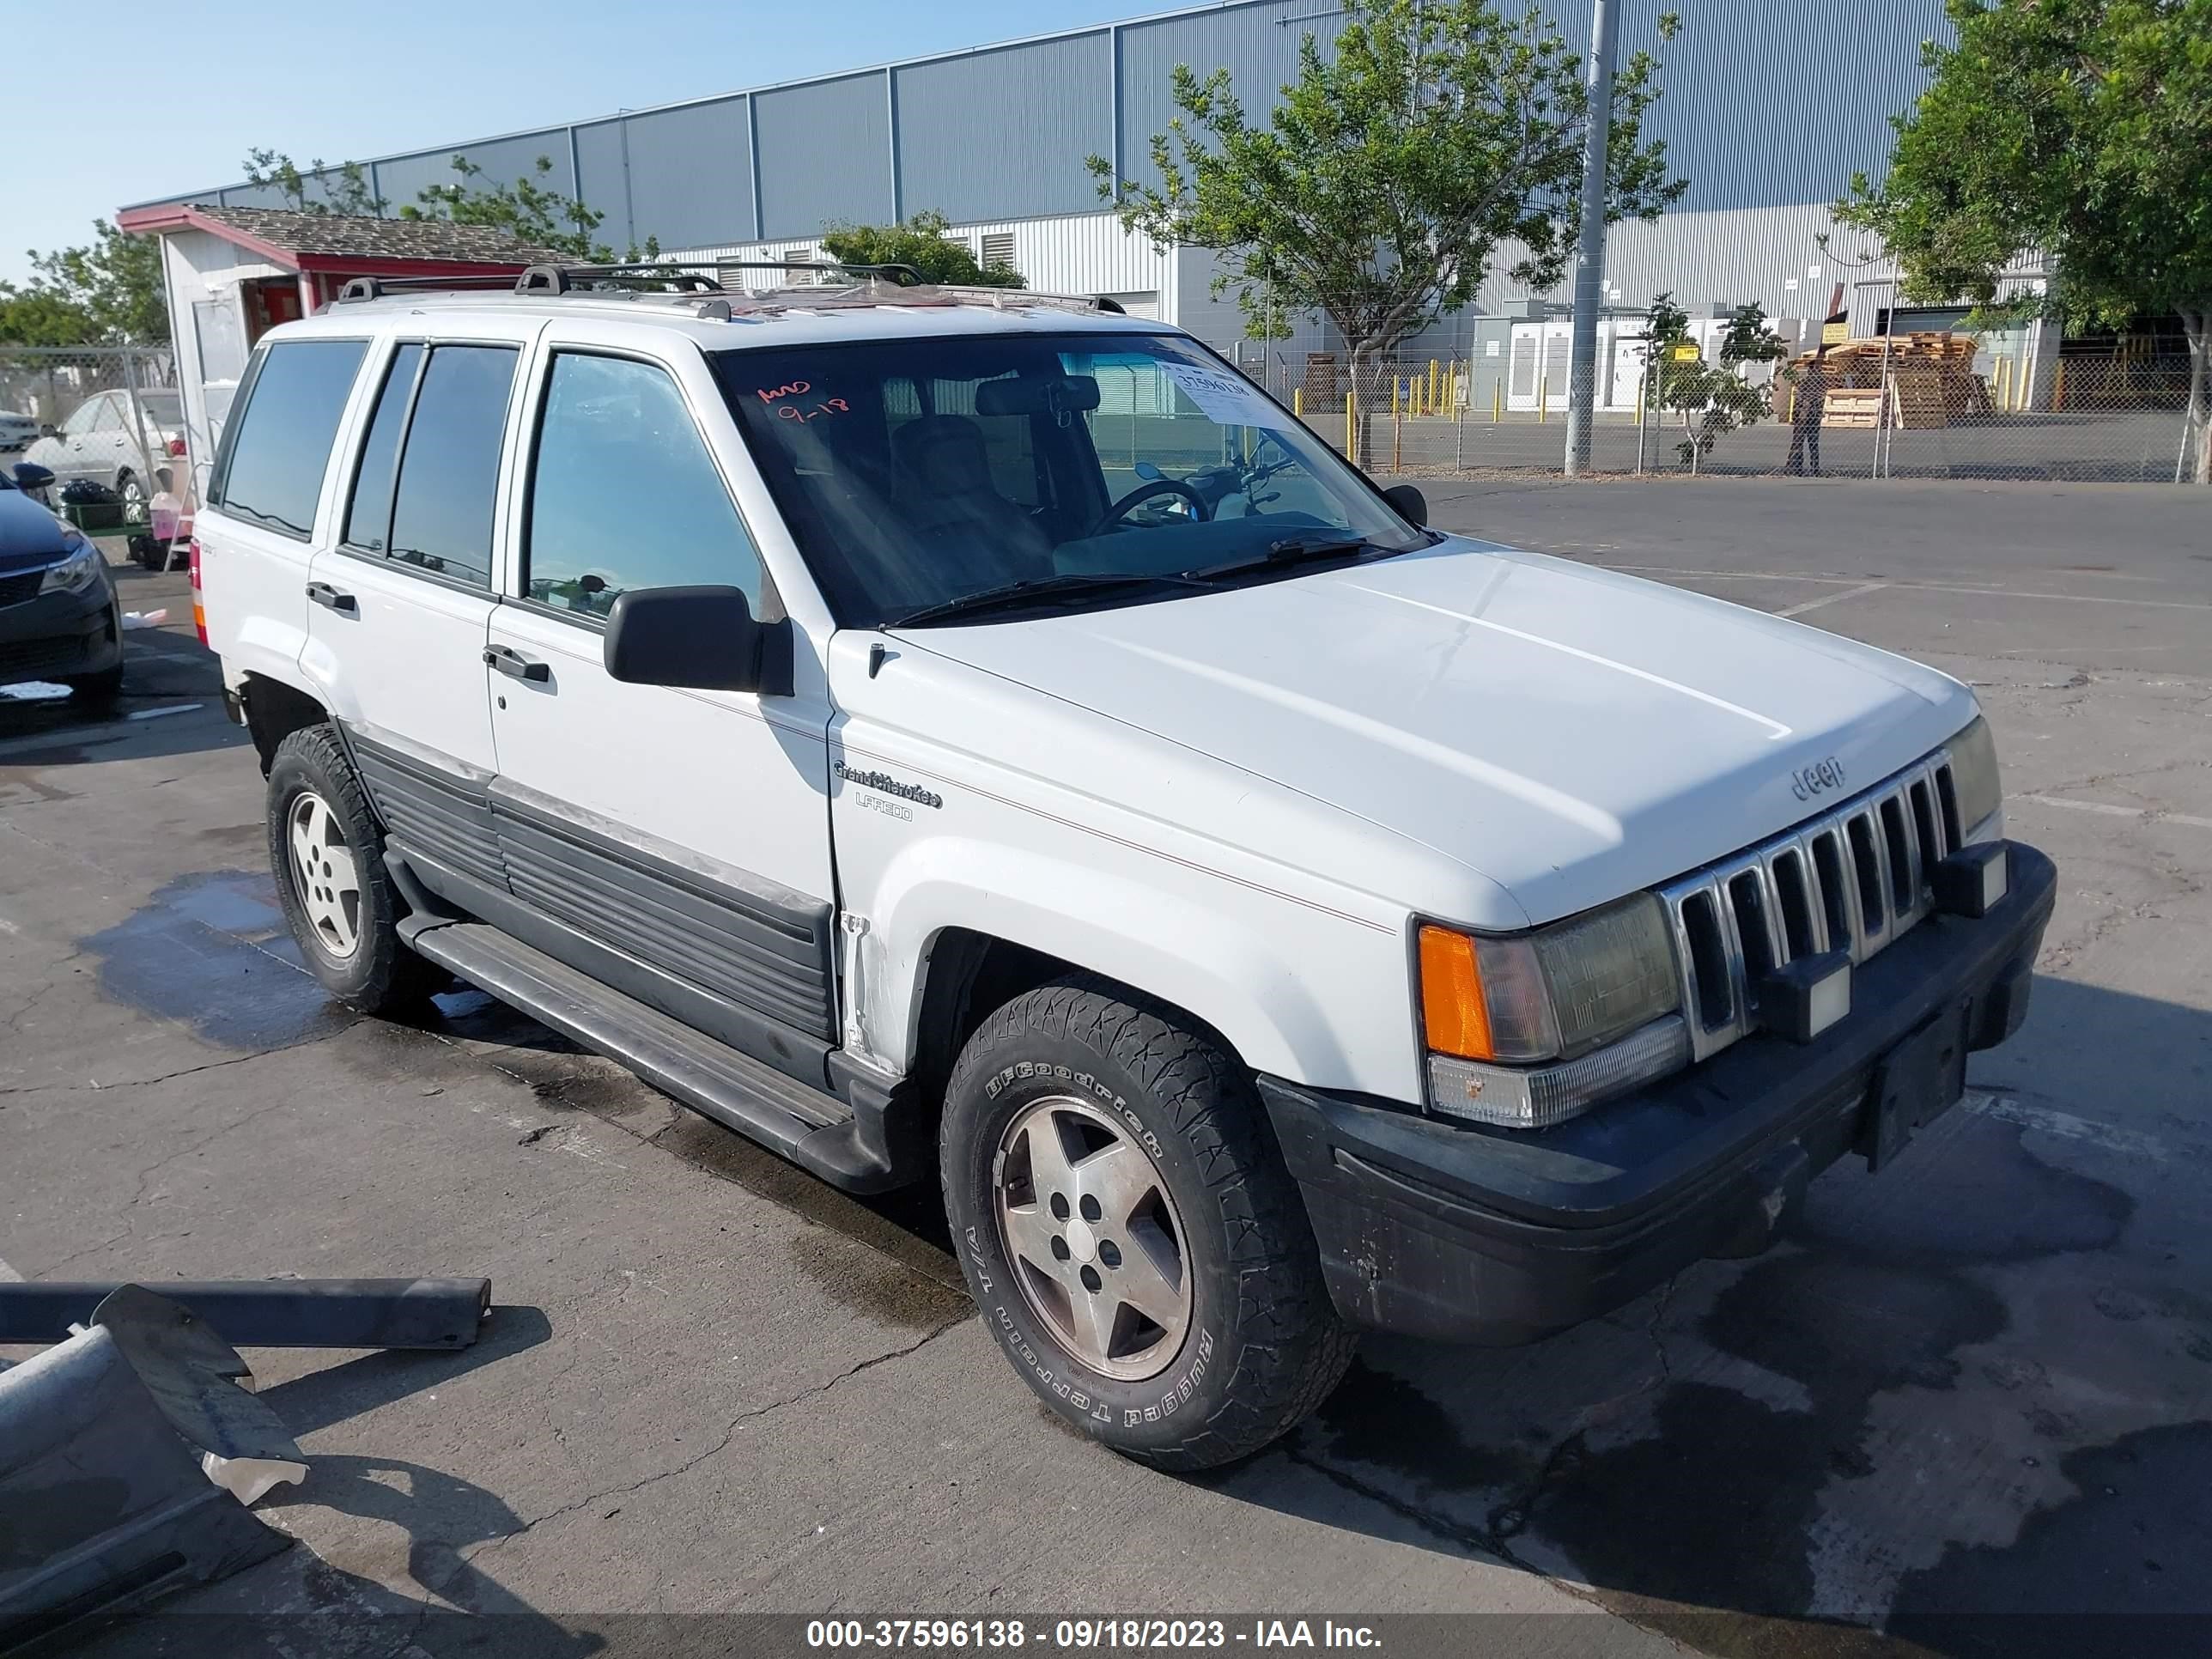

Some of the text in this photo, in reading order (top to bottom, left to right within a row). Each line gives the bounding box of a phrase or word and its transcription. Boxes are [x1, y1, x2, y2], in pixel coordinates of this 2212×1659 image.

[1177, 374, 1250, 397] 37596138
[833, 759, 943, 809] Grand Cherokee
[1791, 757, 1845, 801] Jeep
[855, 792, 913, 822] LAREDO
[985, 1060, 1164, 1159] BFGoodrich
[965, 1224, 1214, 1428] Rugged Terrain T/A
